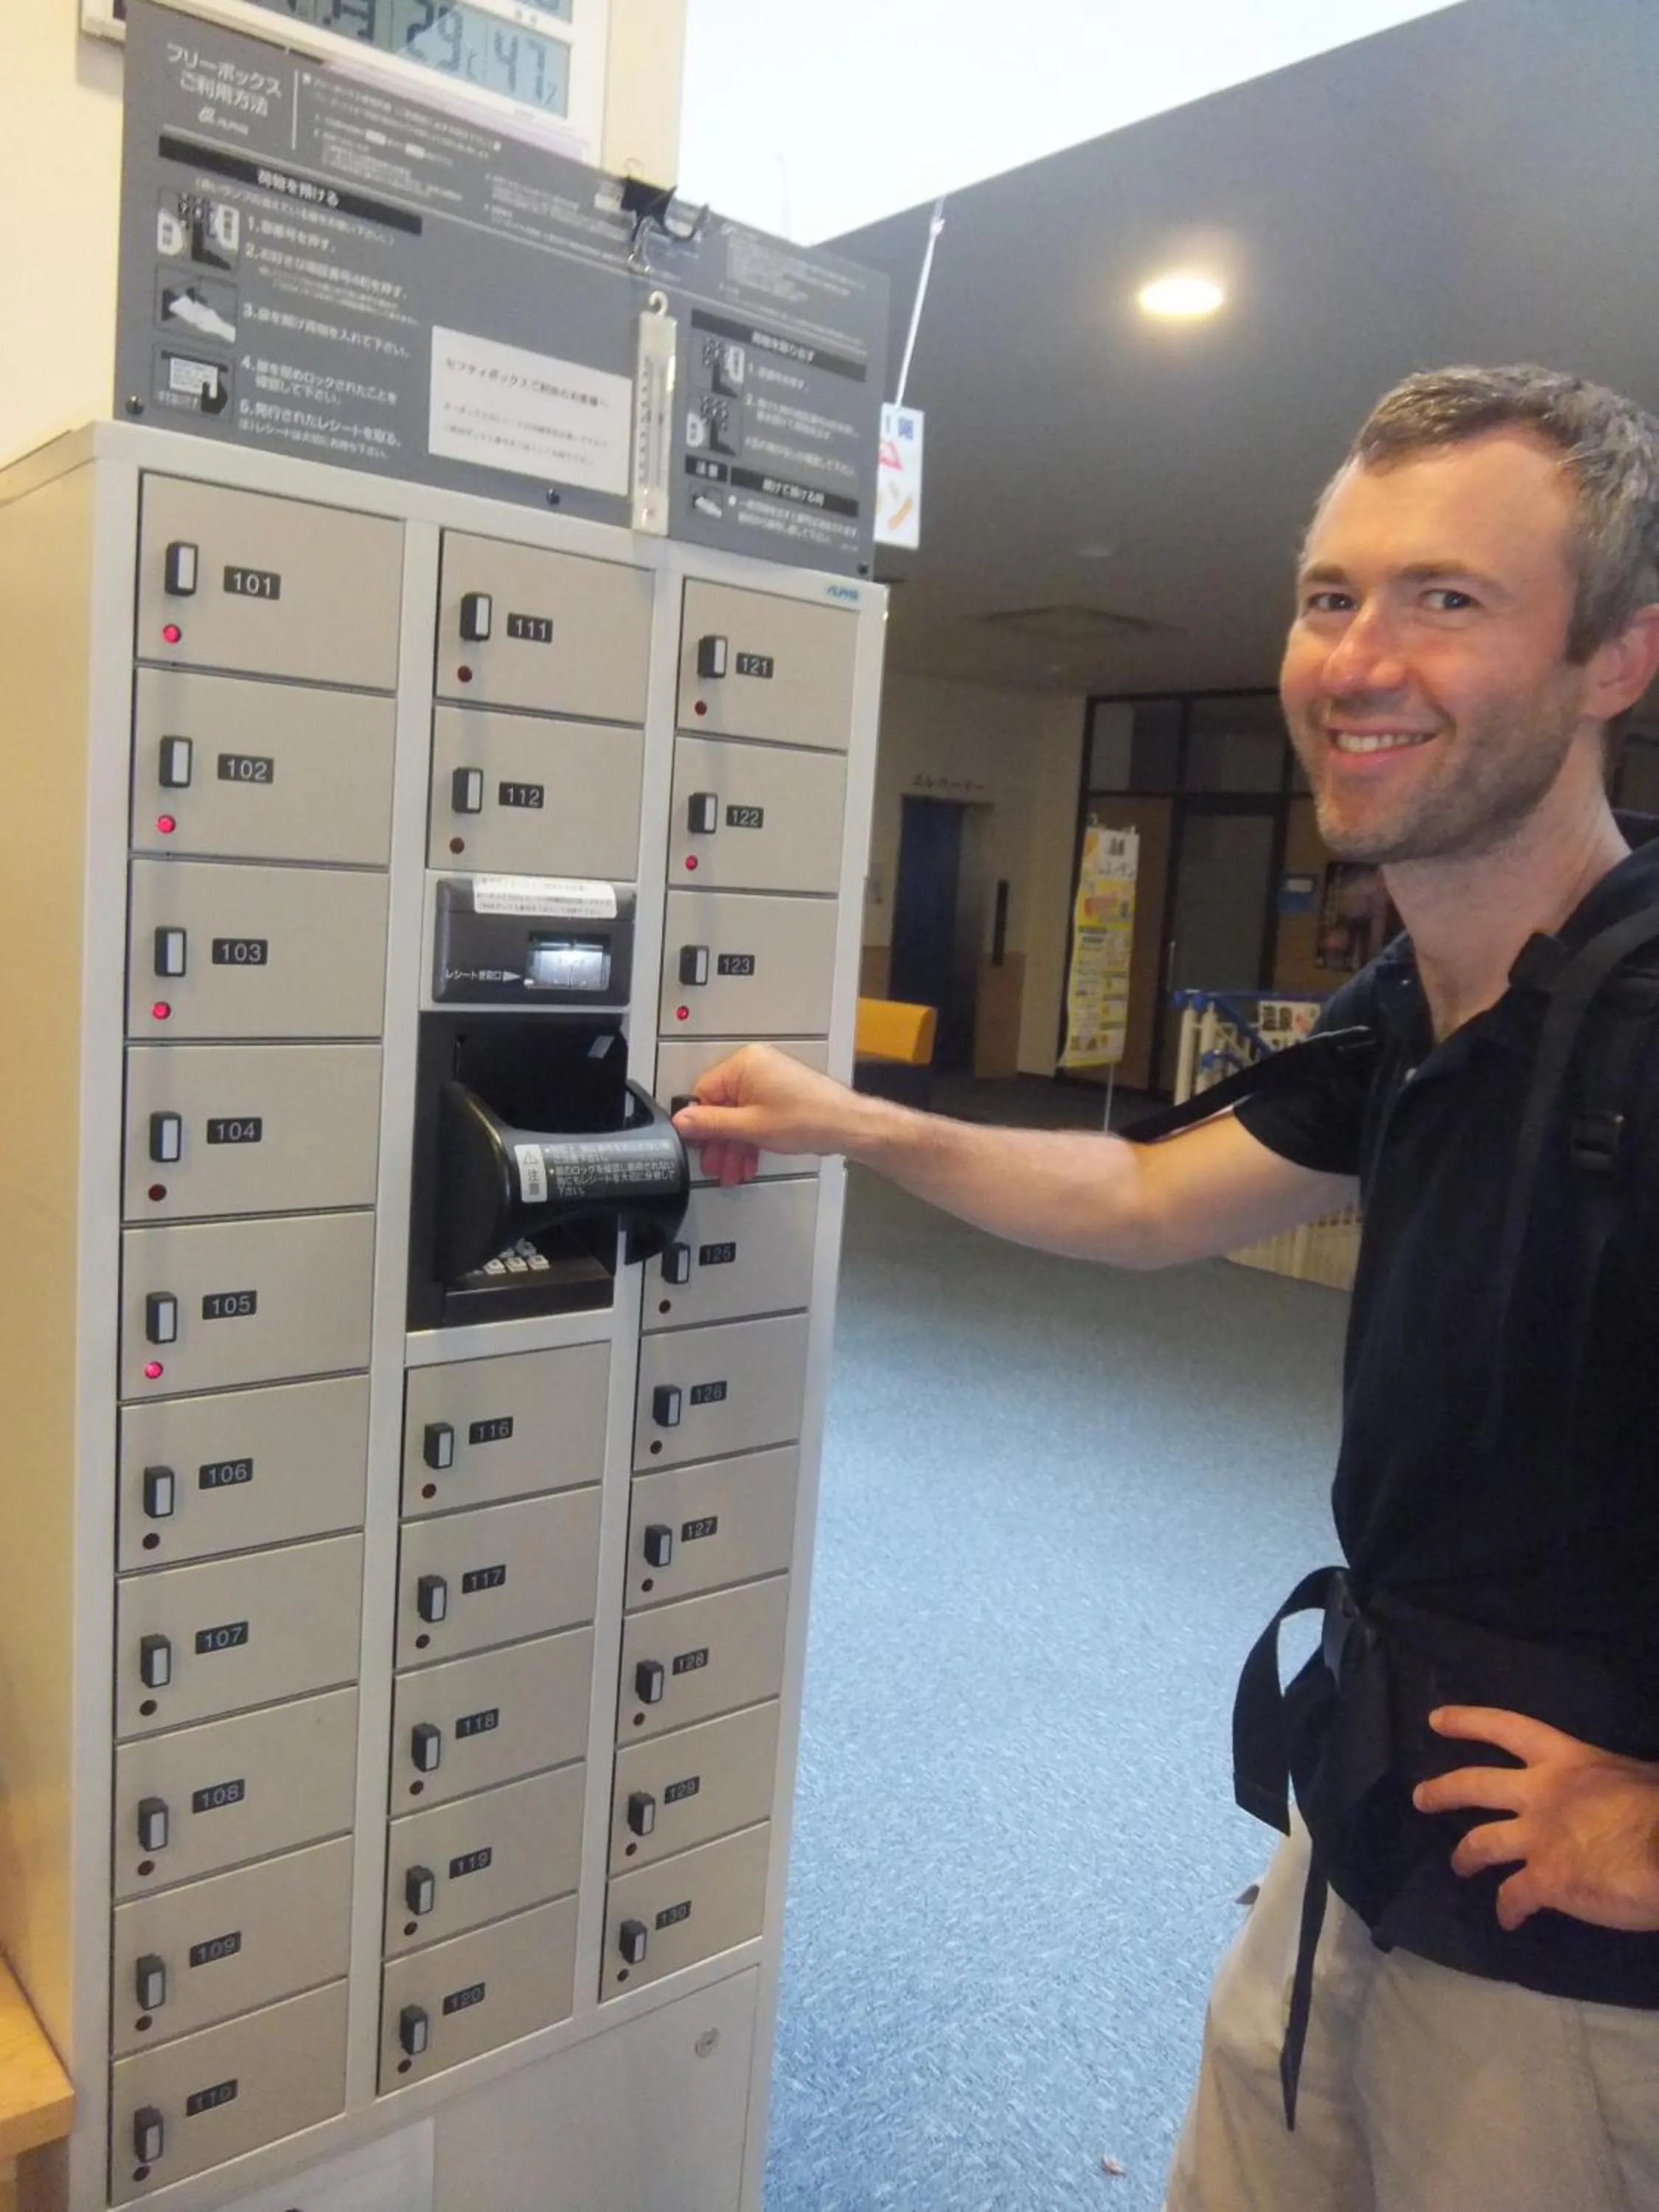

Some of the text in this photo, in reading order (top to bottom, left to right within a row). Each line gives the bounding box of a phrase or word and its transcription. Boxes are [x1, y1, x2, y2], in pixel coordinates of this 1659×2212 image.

[167, 41, 282, 100] フリーボックス
[233, 572, 272, 597] 101
[516, 618, 547, 641] 111
[742, 658, 768, 677] 121
[227, 758, 268, 782] 102
[507, 787, 540, 806] 112
[733, 808, 759, 827] 122
[222, 943, 262, 961] 103
[723, 956, 751, 973] 123
[218, 1121, 255, 1141] 104
[212, 1295, 251, 1316] 105
[478, 1419, 509, 1441] 116
[209, 1463, 248, 1485] 106
[687, 1520, 714, 1539] 127
[470, 1568, 502, 1589] 117
[206, 1626, 243, 1649] 107
[677, 1652, 705, 1672] 128
[463, 1711, 495, 1733] 118
[201, 1784, 238, 1807] 108
[456, 1851, 488, 1874] 119
[198, 1937, 235, 1961] 109
